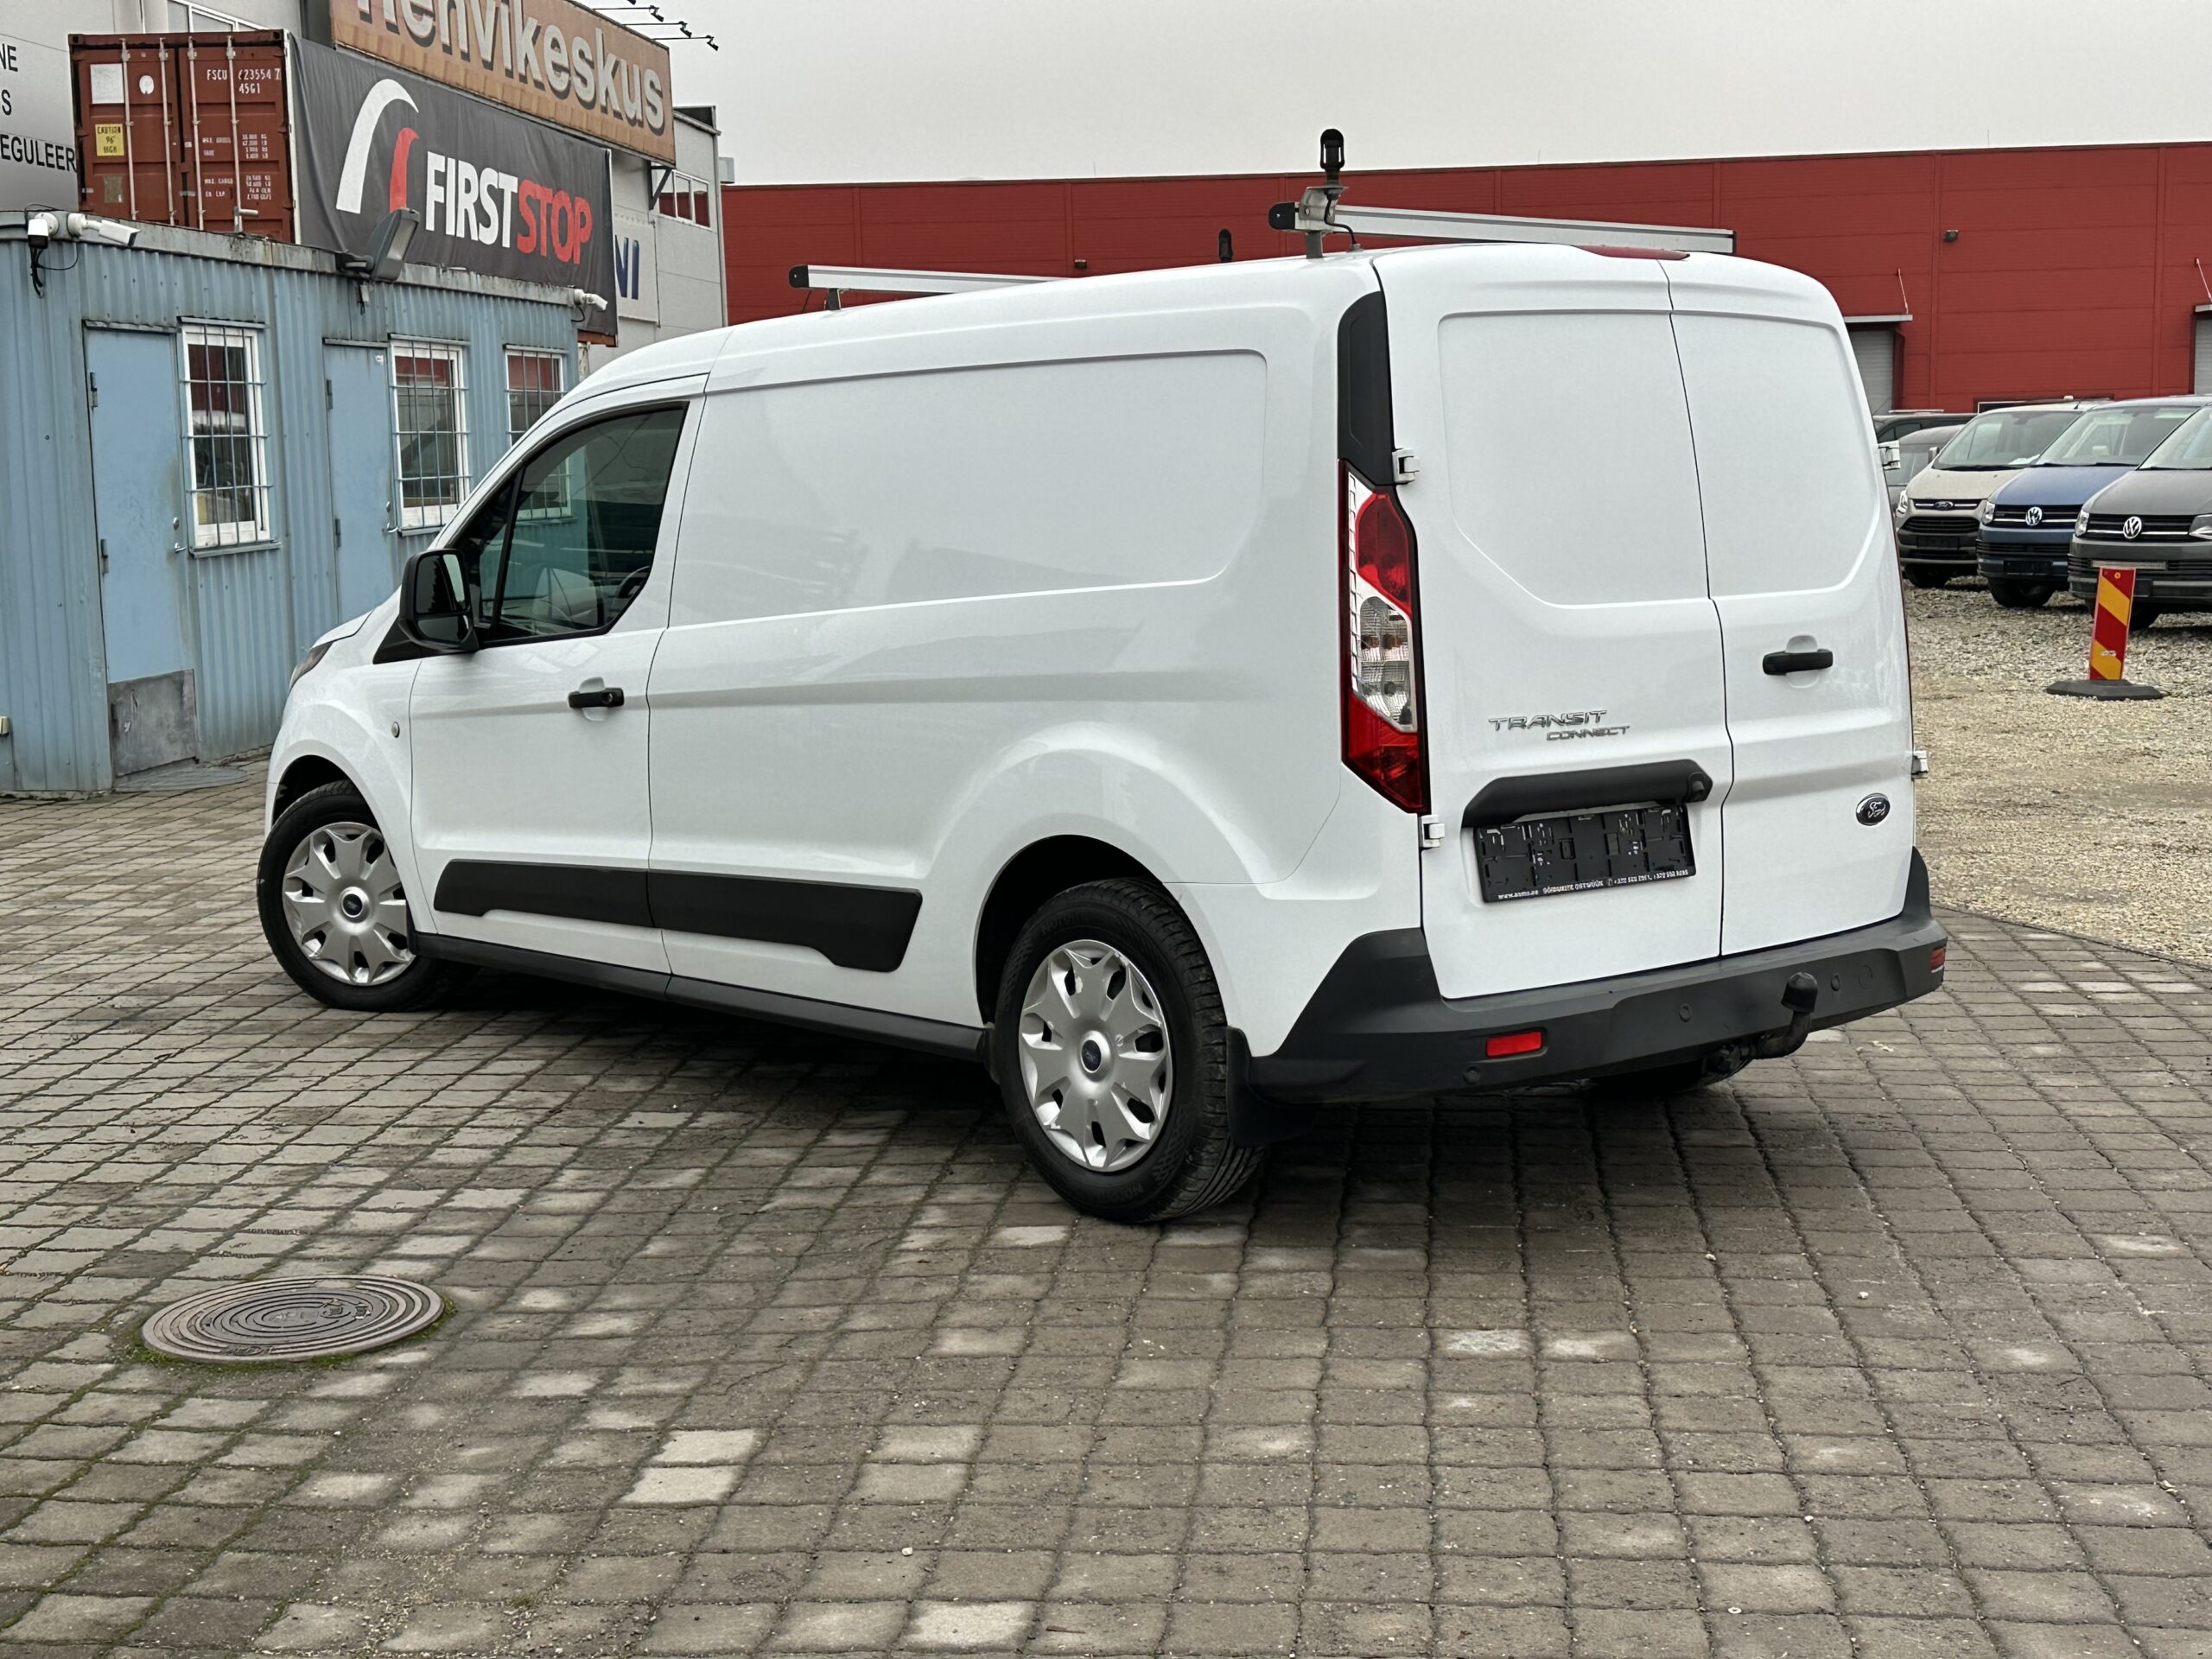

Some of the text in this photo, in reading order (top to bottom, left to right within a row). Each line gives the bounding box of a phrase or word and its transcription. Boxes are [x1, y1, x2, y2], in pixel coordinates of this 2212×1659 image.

[207, 69, 227, 80] FSCU
[358, 0, 664, 134] ehvikeskus
[238, 83, 260, 94] 45G1
[1488, 710, 1607, 731] TRANSIT
[1547, 726, 1630, 741] CONNECT
